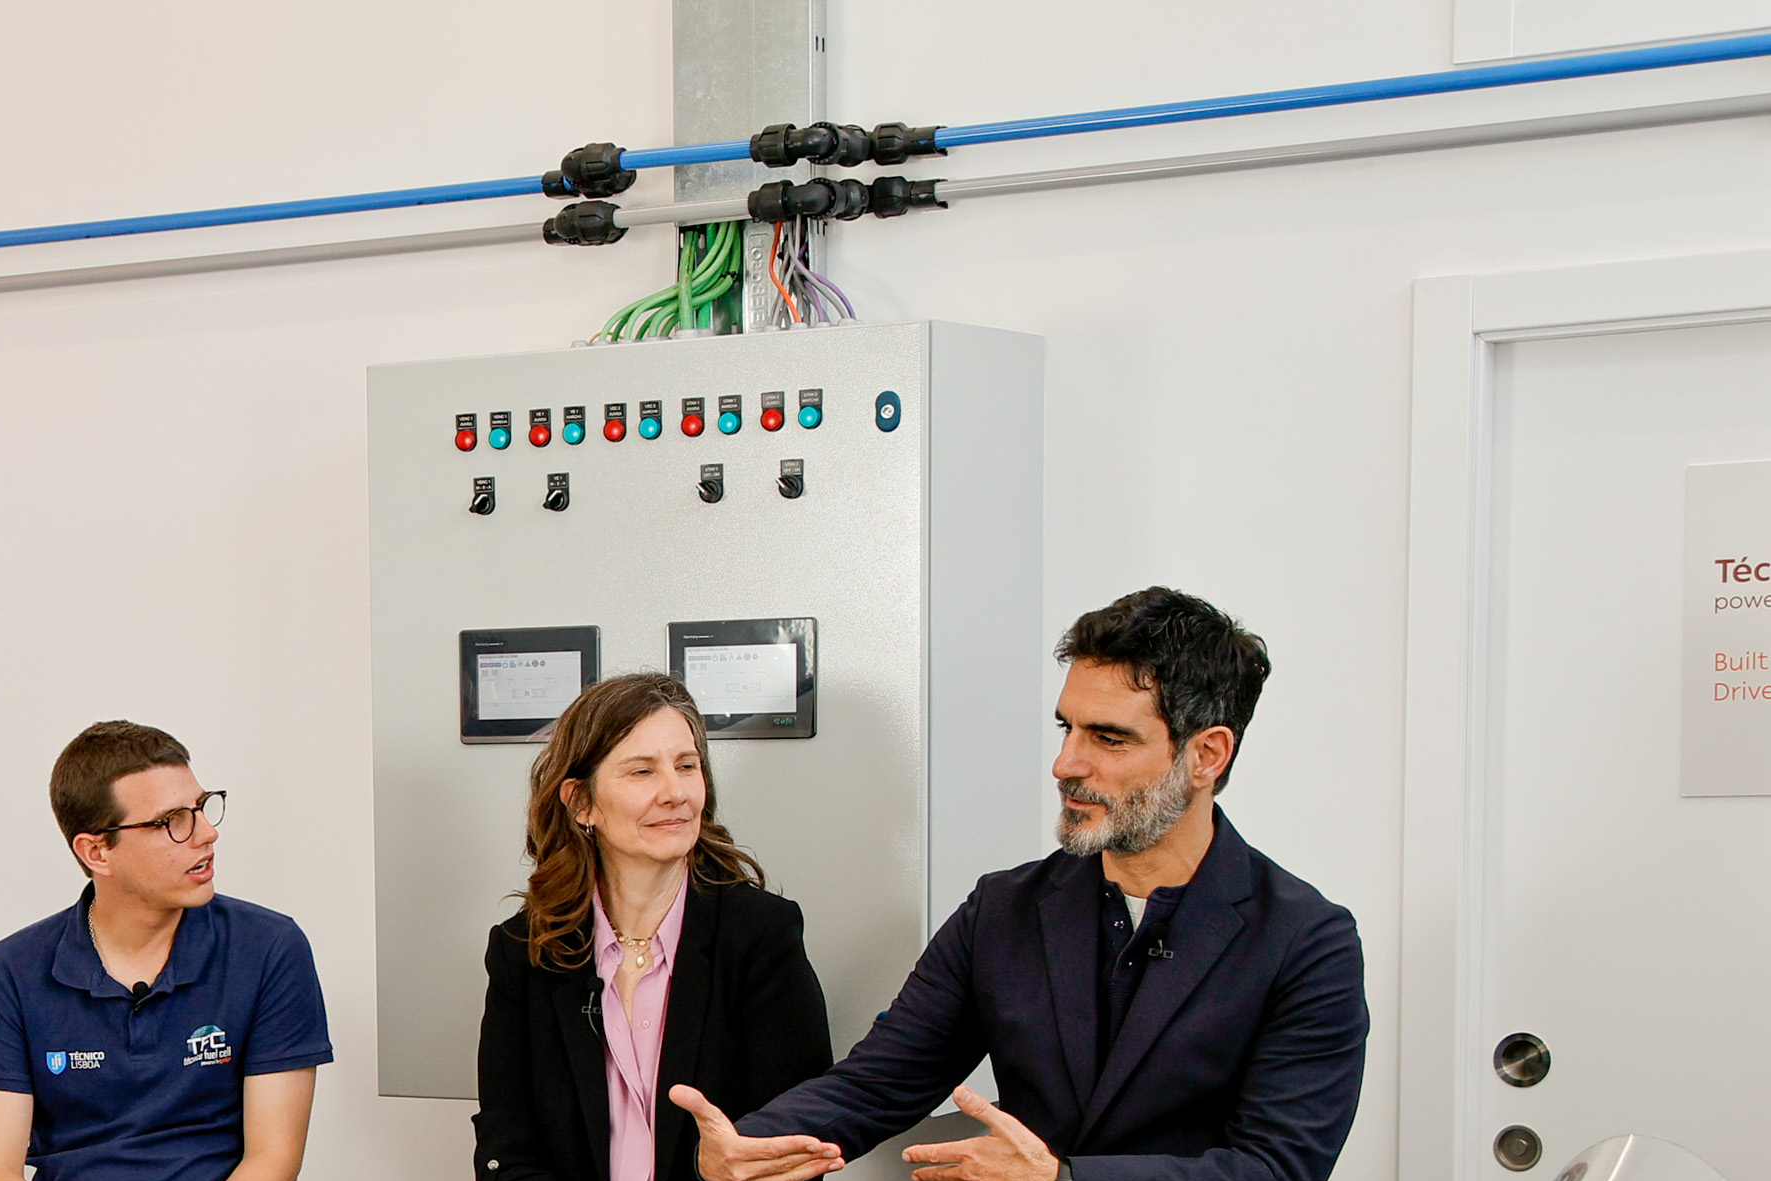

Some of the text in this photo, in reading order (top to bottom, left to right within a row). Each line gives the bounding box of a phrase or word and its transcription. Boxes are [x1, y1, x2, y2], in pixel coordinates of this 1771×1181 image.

[1714, 651, 1769, 672] Built
[186, 1031, 226, 1055] TFC
[68, 1050, 105, 1061] TÉCNICO
[204, 1048, 218, 1060] fuel
[219, 1045, 232, 1058] cell
[71, 1060, 101, 1070] LISBOA
